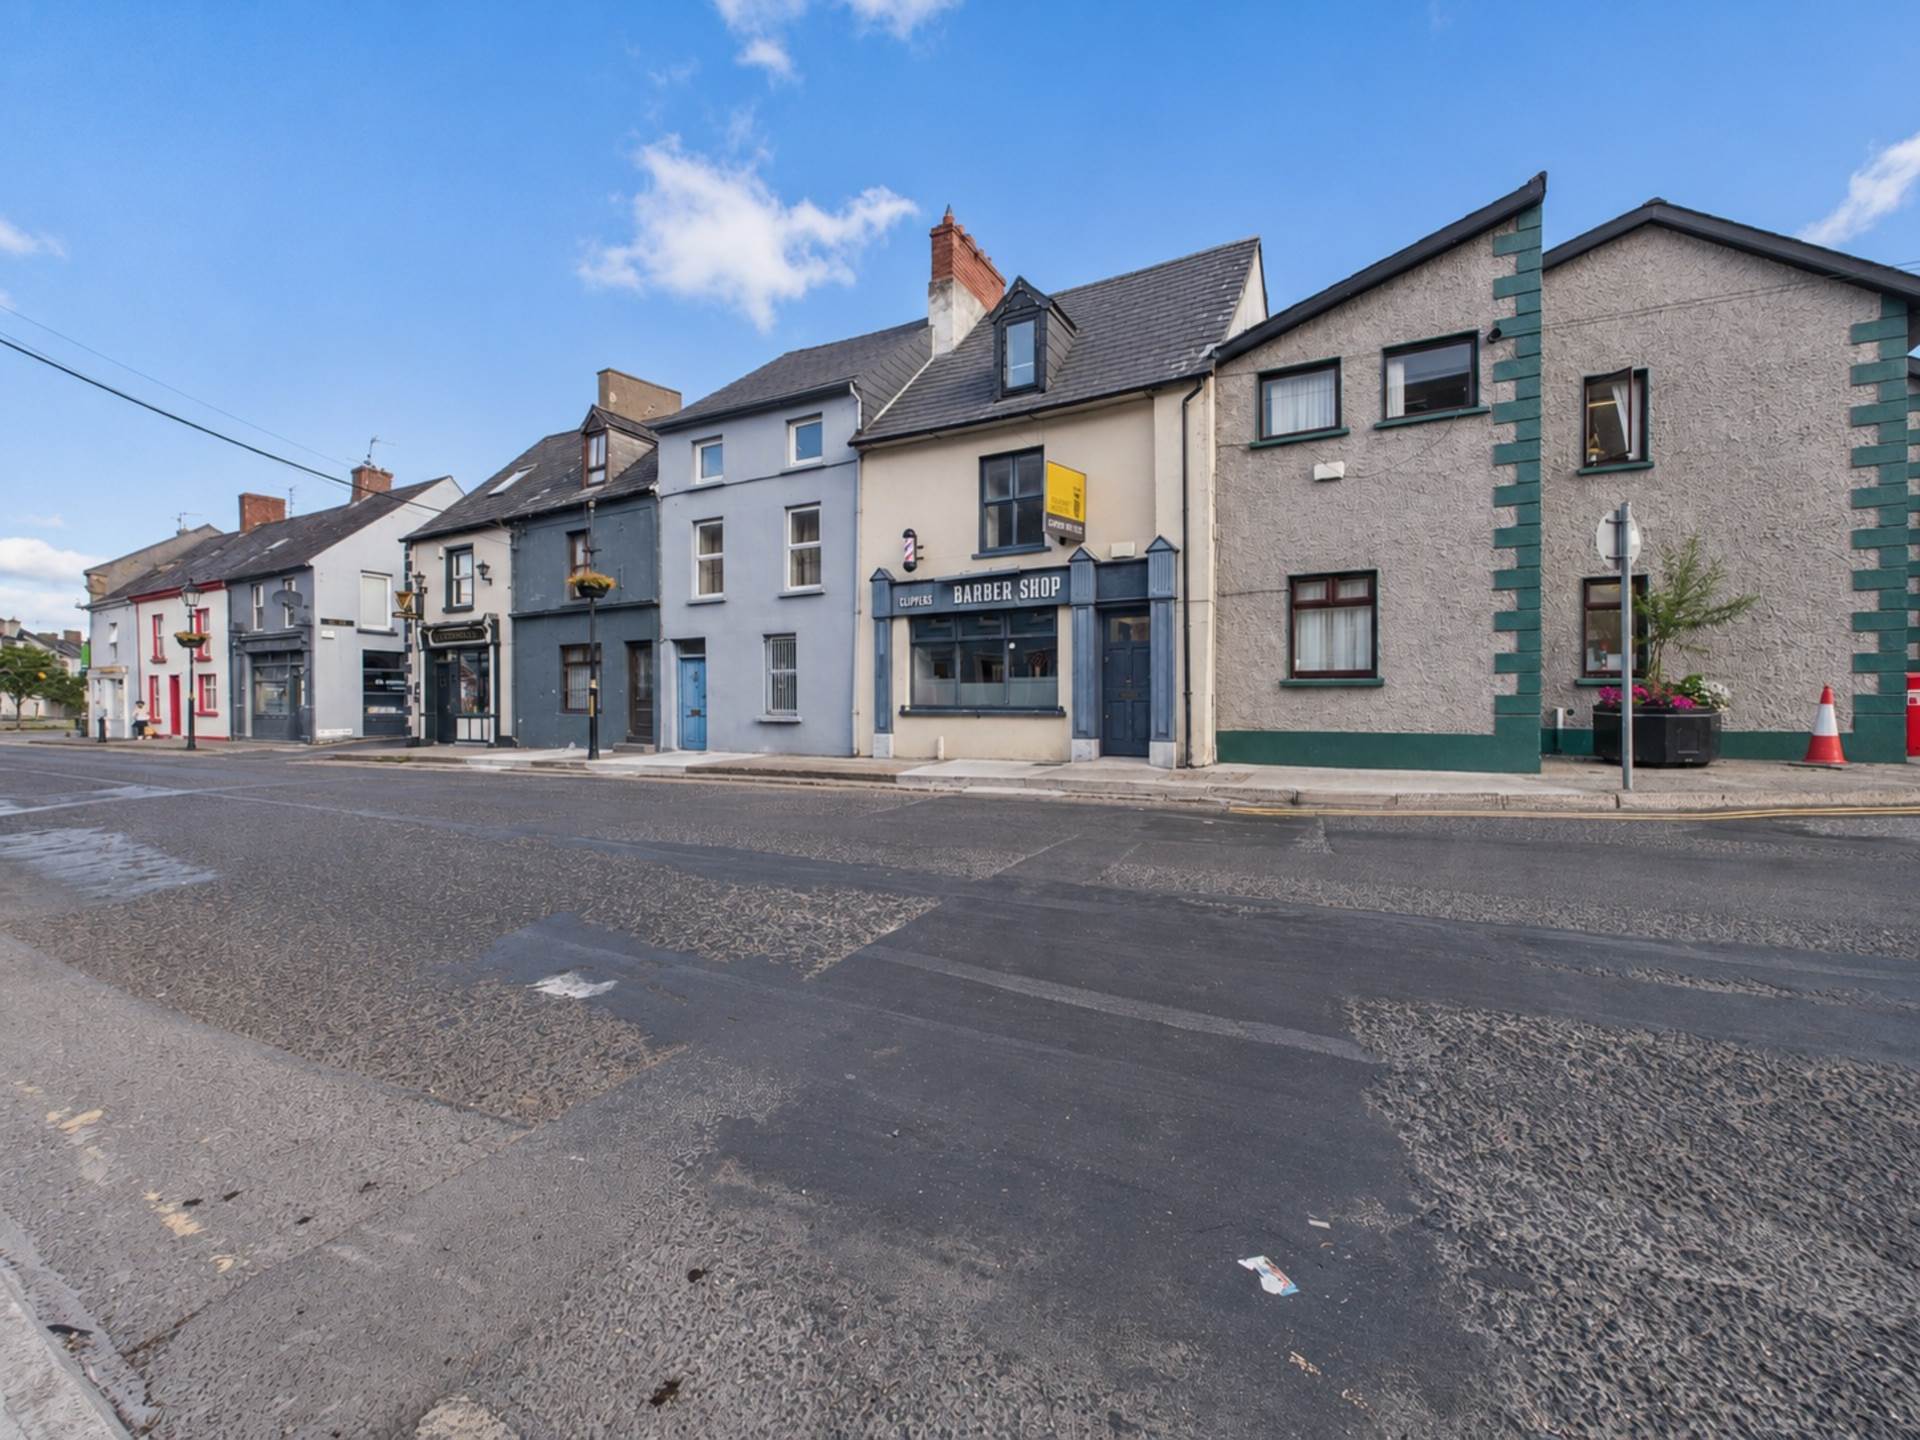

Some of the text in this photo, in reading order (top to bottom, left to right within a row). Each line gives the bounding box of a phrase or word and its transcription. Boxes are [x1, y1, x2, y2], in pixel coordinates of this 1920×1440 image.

[953, 576, 1061, 604] BARBER SHOP
[899, 595, 933, 608] CLIPPERS
